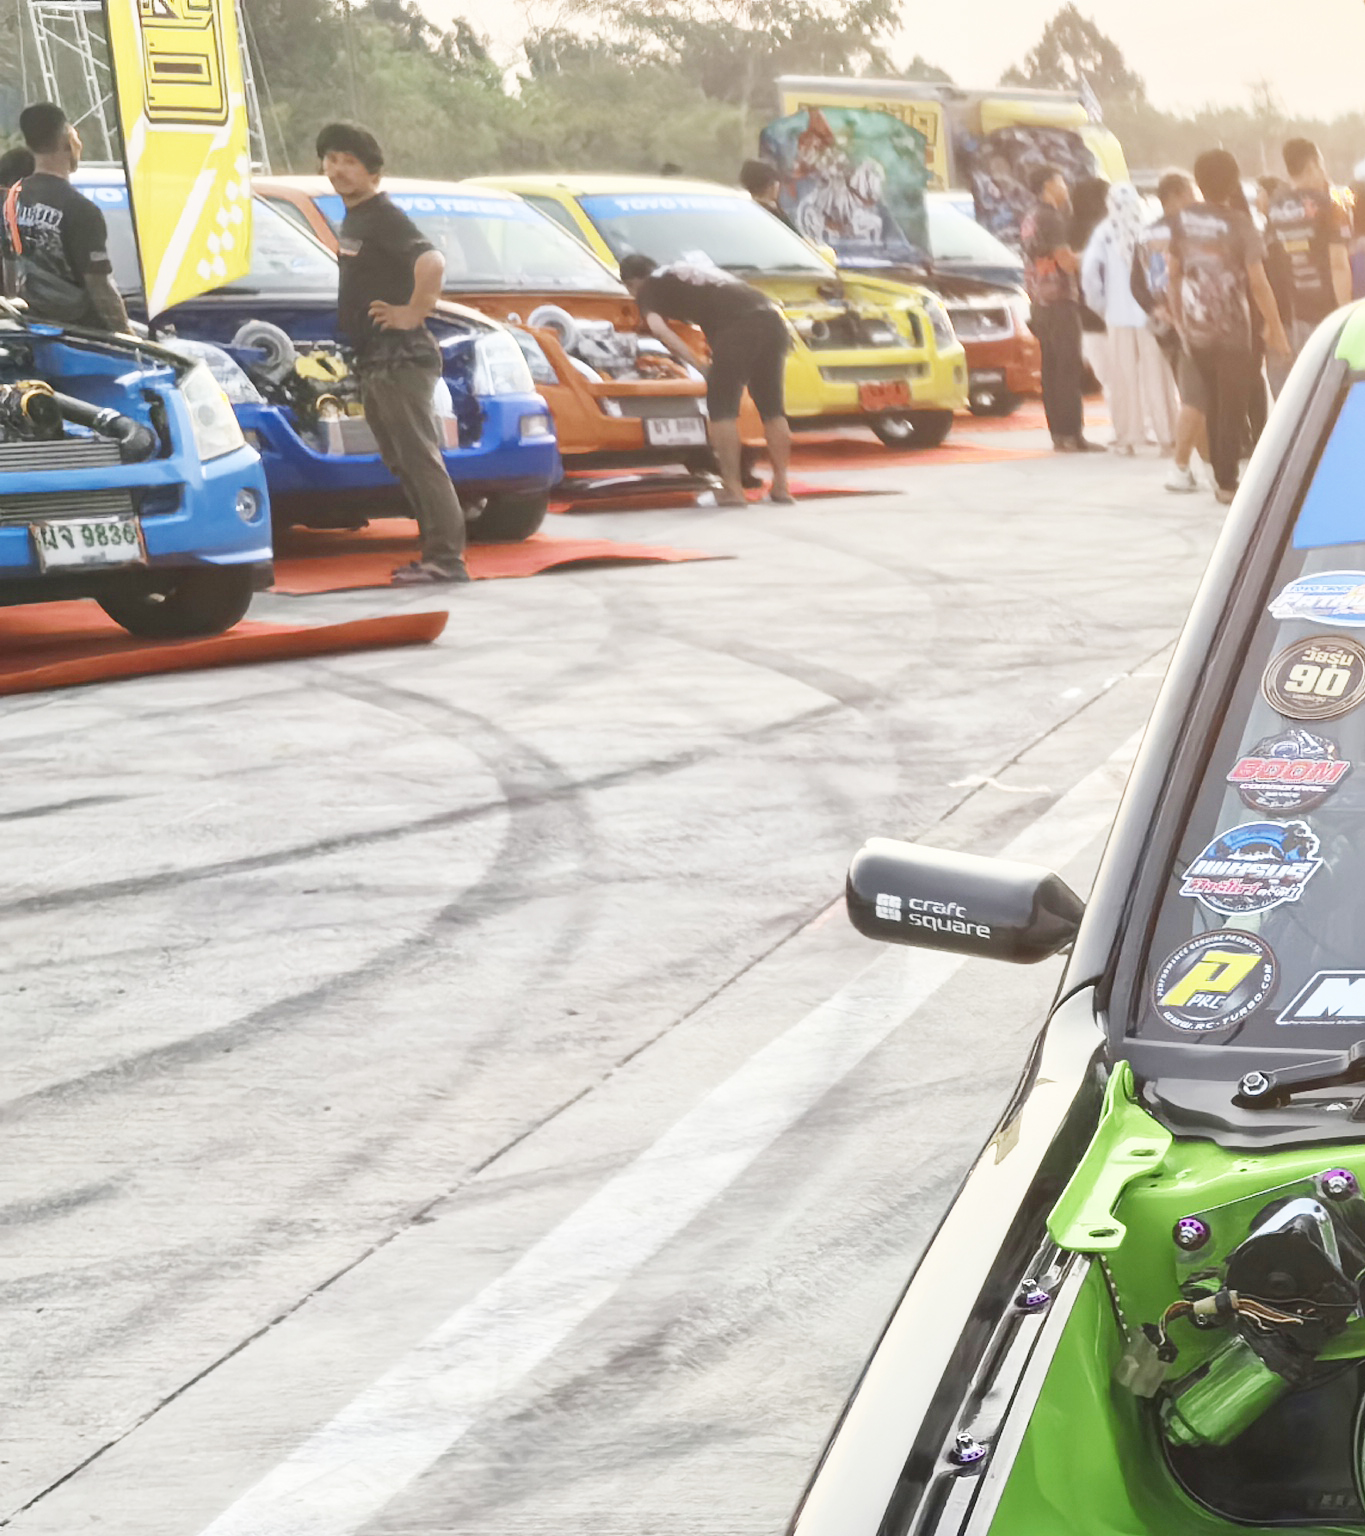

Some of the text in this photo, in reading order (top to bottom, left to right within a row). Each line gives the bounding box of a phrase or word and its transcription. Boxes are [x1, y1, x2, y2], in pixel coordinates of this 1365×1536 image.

[1301, 646, 1355, 669] วัยรุ่น
[1283, 663, 1352, 697] 90
[908, 897, 968, 919] craft
[908, 913, 992, 940] square
[1186, 993, 1227, 1010] PRC
